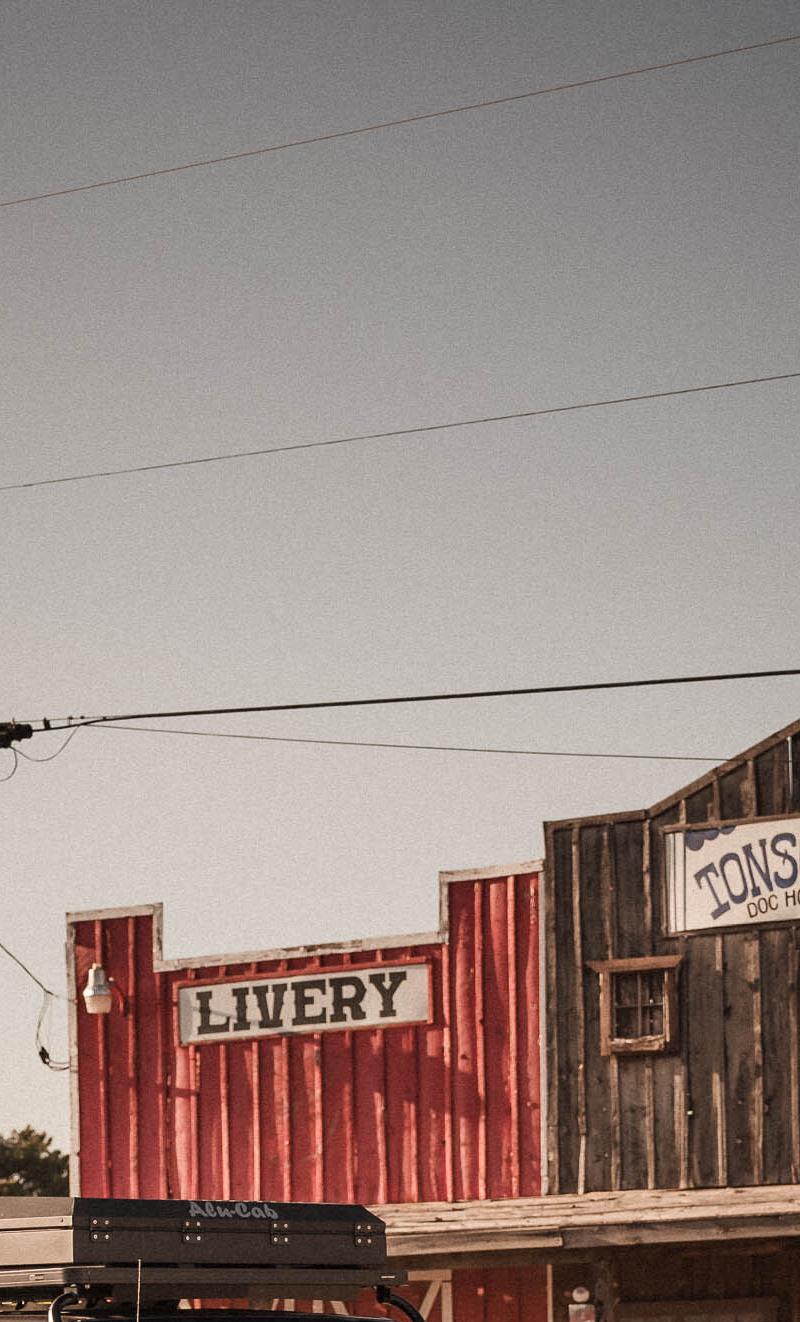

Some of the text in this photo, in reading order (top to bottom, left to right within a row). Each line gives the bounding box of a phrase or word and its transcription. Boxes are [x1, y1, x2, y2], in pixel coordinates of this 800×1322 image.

[747, 889, 800, 918] DOC H
[196, 970, 407, 1035] LIVERY
[189, 1201, 279, 1219] Alu-Cab
